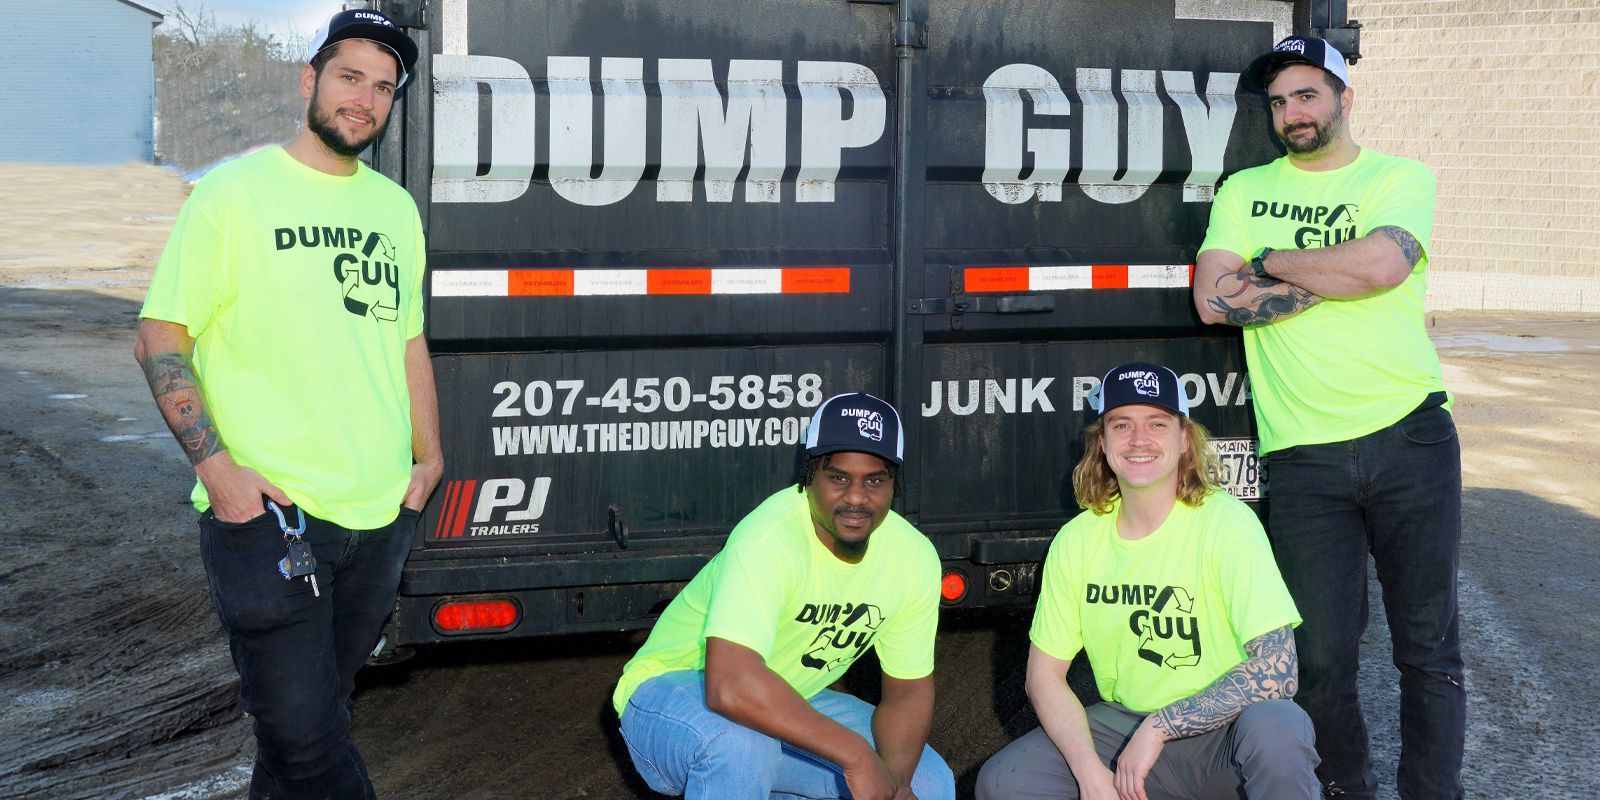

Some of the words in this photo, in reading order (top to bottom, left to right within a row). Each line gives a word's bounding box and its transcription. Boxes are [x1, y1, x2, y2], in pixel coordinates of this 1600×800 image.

[354, 13, 385, 22] DUMP
[432, 54, 886, 206] DUMP
[982, 63, 1242, 204] GUY
[1251, 200, 1329, 225] DUMP
[274, 226, 363, 251] DUMP
[333, 253, 400, 310] GUY
[1119, 371, 1145, 380] DUMP
[1134, 379, 1159, 396] GUY
[491, 373, 823, 418] 207-450-5858
[921, 377, 1056, 418] JUNK
[841, 408, 870, 418] DUMP
[857, 417, 883, 439] GUY
[1217, 441, 1256, 453] MAINE
[473, 476, 552, 523] PJ
[470, 523, 540, 537] TRAILERS
[1086, 583, 1157, 606] DUMP
[1129, 610, 1201, 656] GUY
